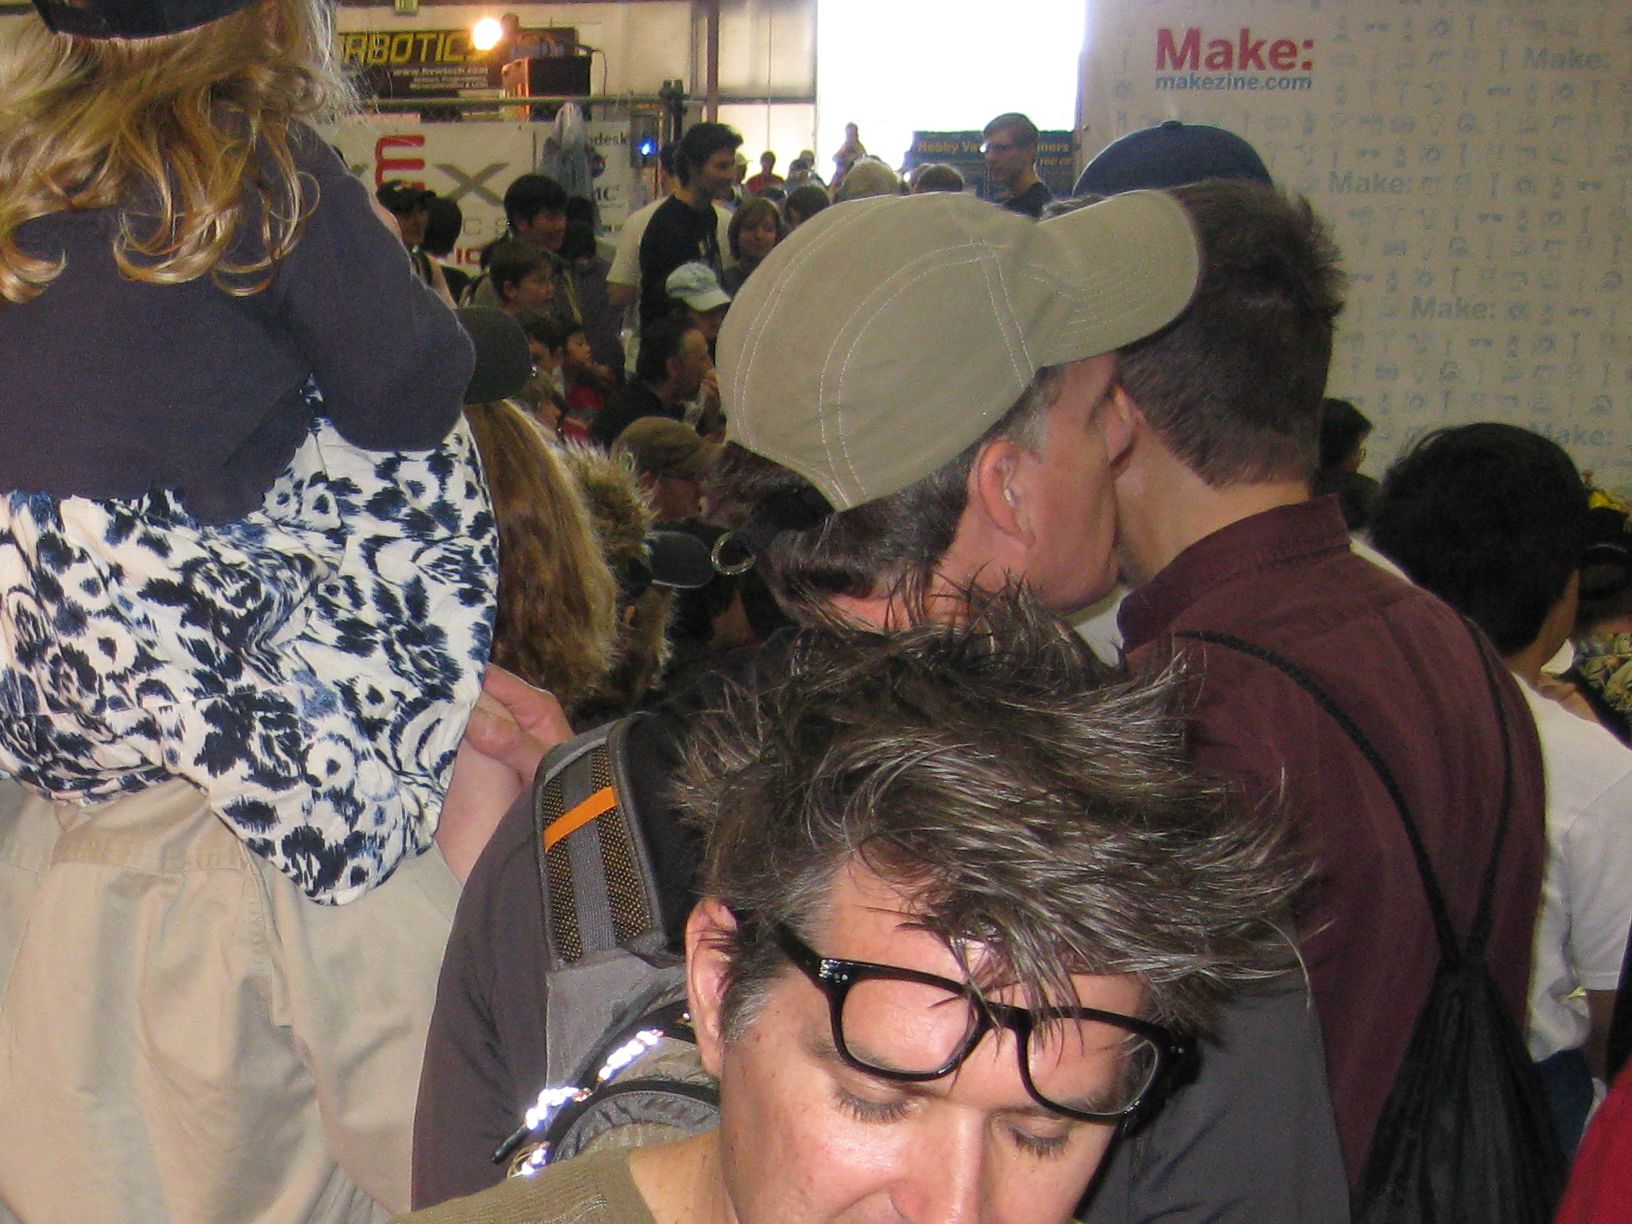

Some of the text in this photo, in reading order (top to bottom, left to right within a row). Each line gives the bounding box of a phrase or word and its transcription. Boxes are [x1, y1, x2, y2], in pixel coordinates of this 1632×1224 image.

[1156, 28, 1314, 72] Make:
[1523, 47, 1610, 71] Make:
[1156, 73, 1312, 92] makezine.com
[1328, 171, 1414, 195] Make:
[1412, 295, 1496, 319] Make:
